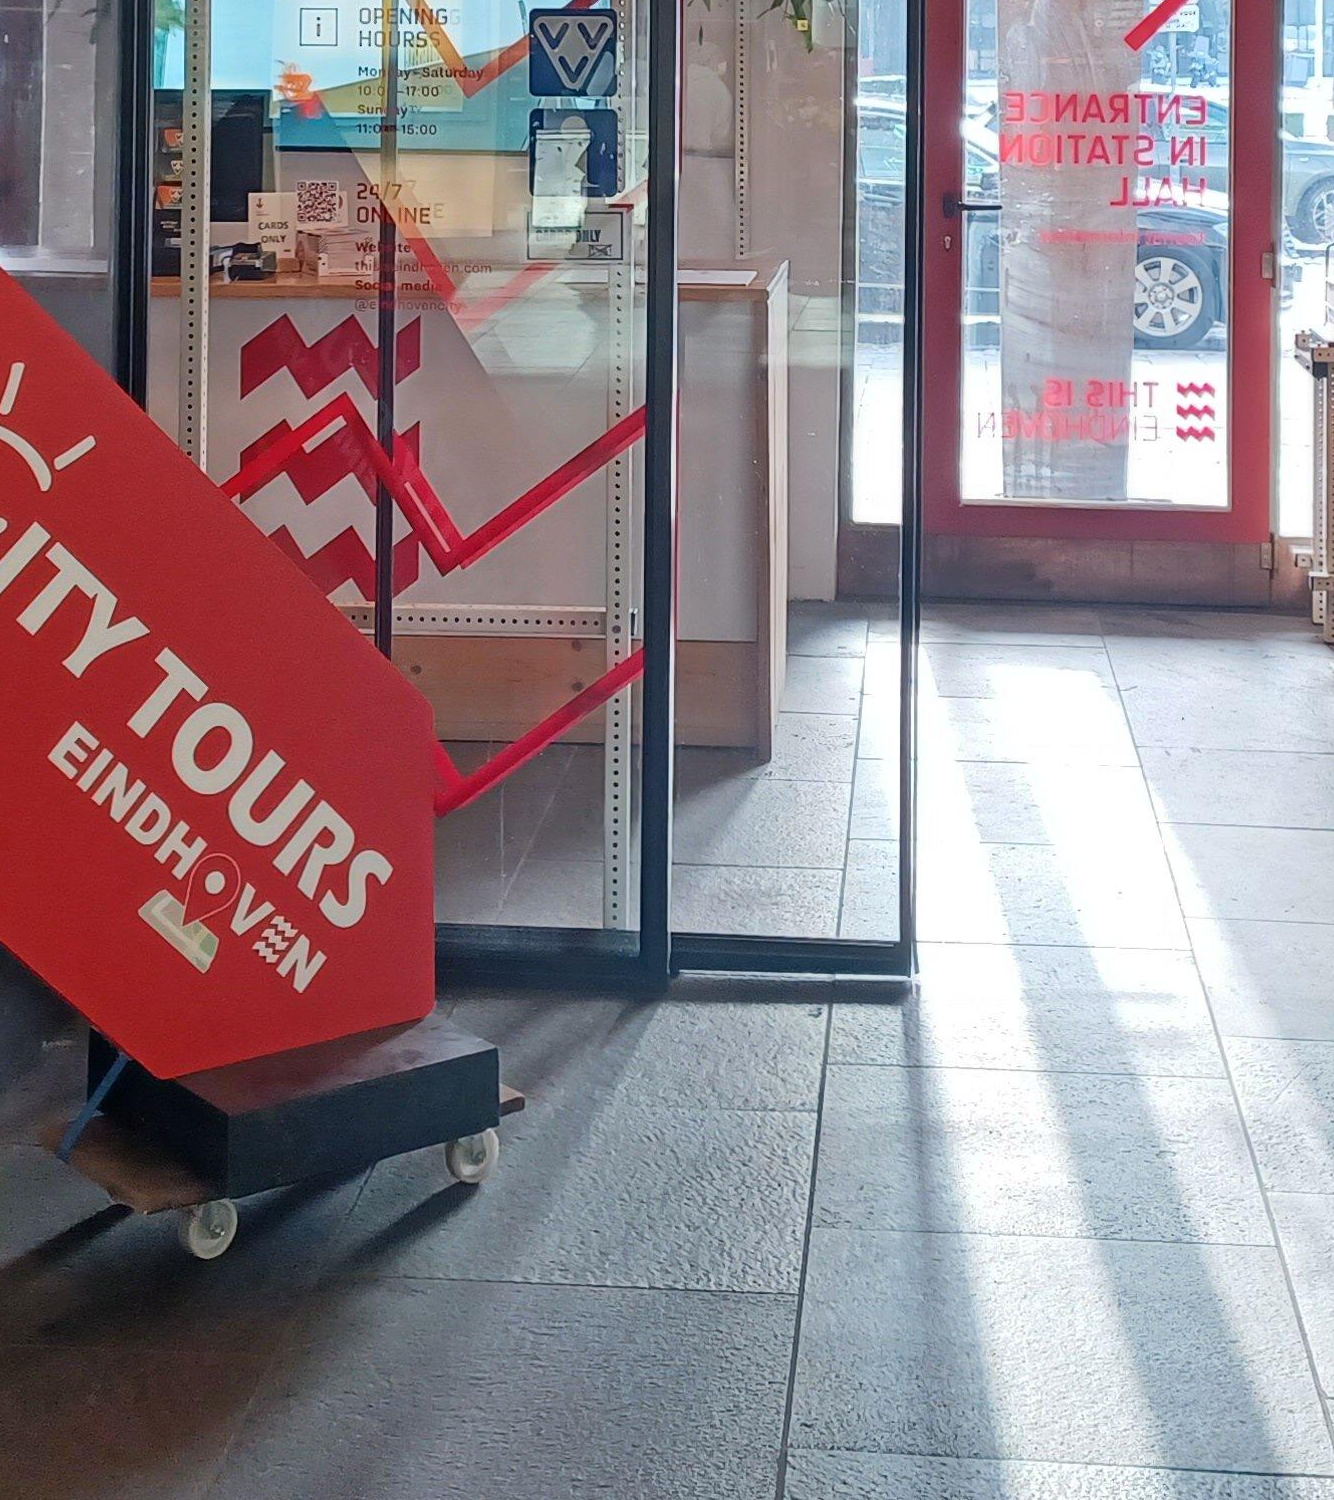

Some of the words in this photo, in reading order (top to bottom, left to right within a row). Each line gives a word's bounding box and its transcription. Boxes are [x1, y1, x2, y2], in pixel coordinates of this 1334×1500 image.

[358, 7, 449, 26] OPENING
[358, 30, 429, 48] HOURS
[357, 104, 408, 119] Sunay
[356, 182, 402, 201] 24/7
[356, 206, 432, 225] ONINE
[258, 221, 289, 230] CARDS
[261, 234, 287, 243] ONLY
[355, 241, 411, 253] Wete
[127, 647, 393, 929] TOURS
[47, 720, 328, 993] EINDHOVEN
